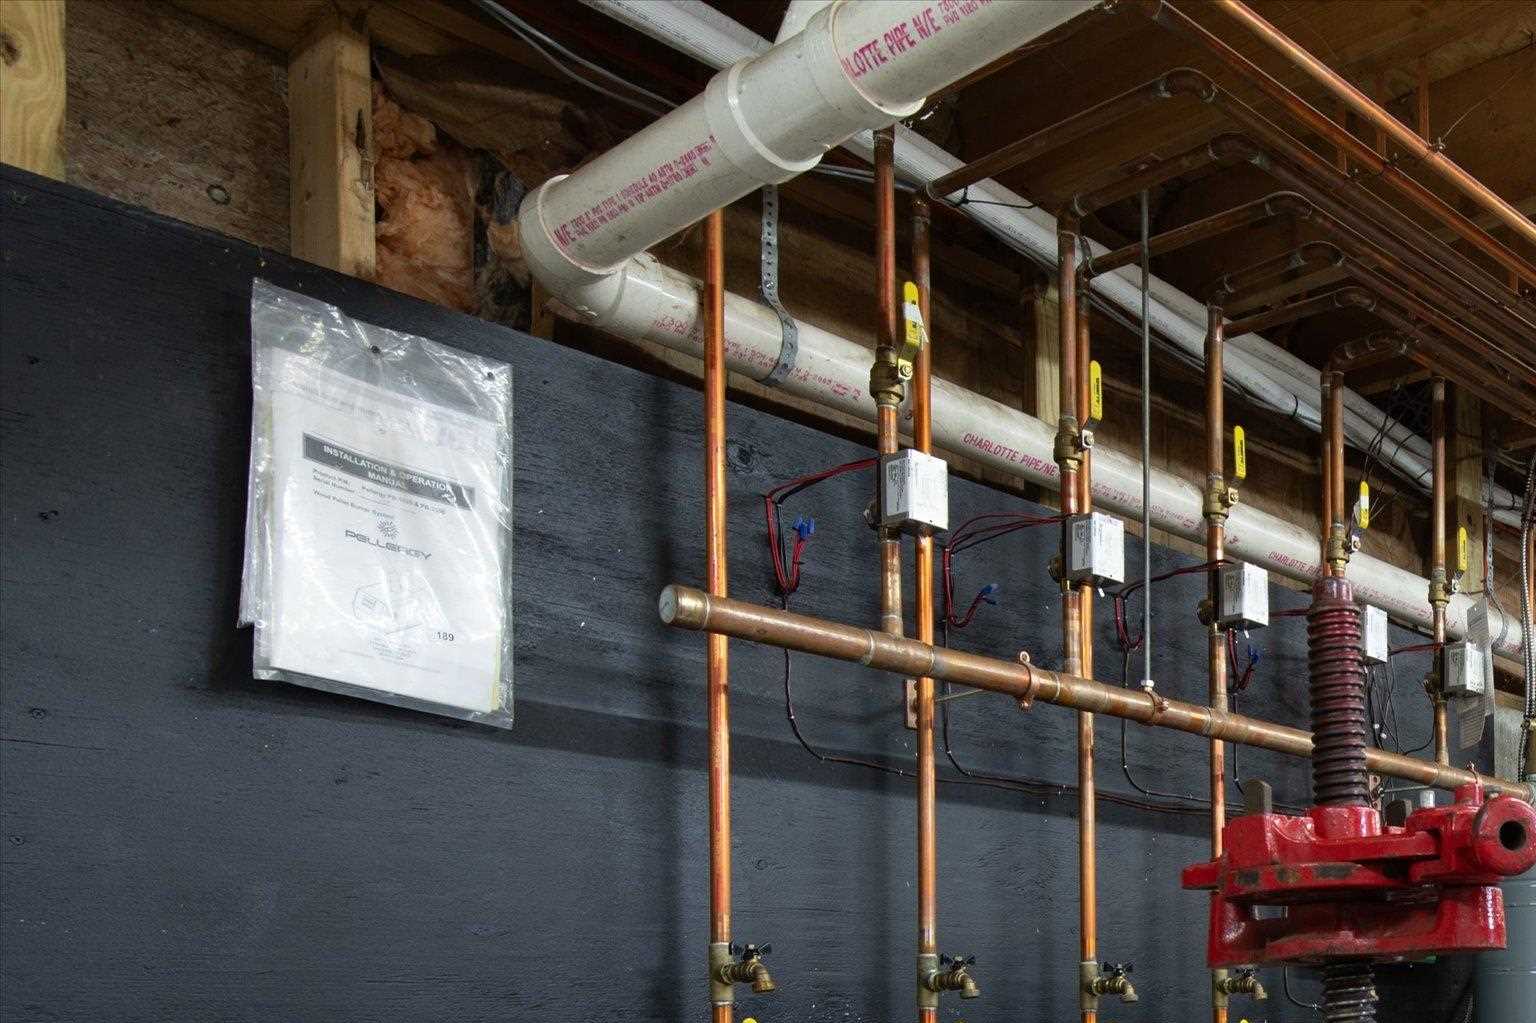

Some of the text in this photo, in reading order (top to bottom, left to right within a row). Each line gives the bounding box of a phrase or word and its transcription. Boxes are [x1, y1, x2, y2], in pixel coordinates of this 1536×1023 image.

[883, 22, 917, 57] PIPE
[911, 7, 943, 41] N/E
[322, 445, 388, 475] INSTALLATION
[961, 432, 1019, 463] CHARLOTTE
